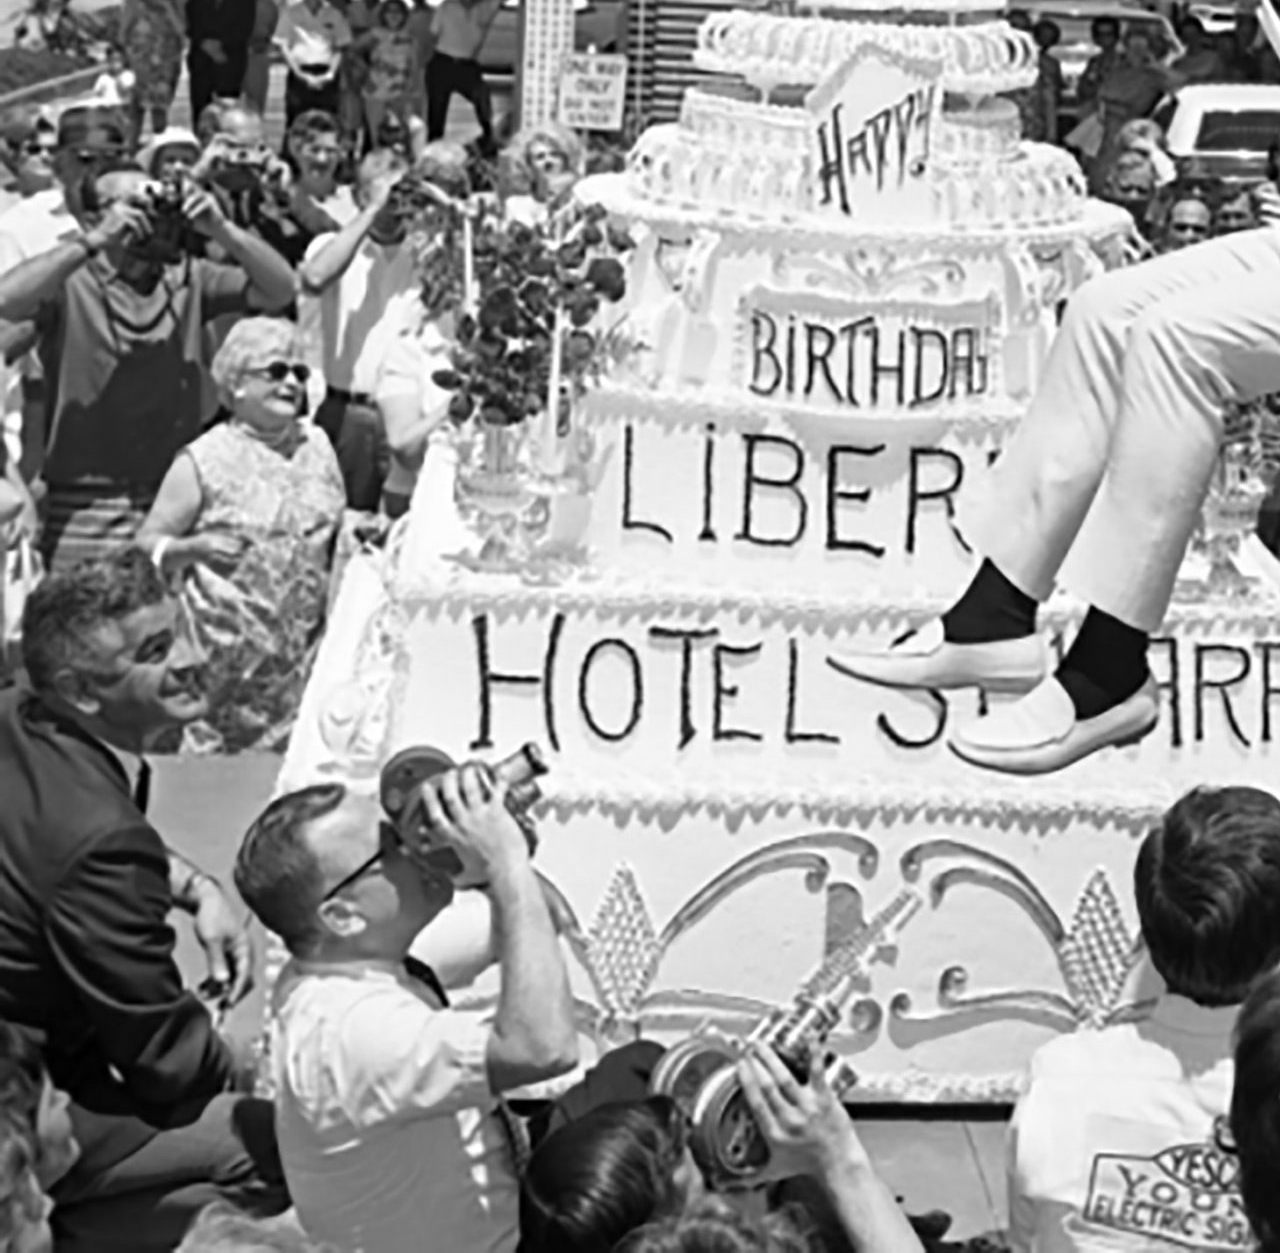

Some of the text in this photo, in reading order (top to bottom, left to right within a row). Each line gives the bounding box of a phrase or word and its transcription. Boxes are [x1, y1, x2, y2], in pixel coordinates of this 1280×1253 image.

[621, 421, 1000, 558] LIBER
[469, 613, 840, 750] HOTEL
[1091, 1193, 1250, 1246] ELECTRIC SIG
